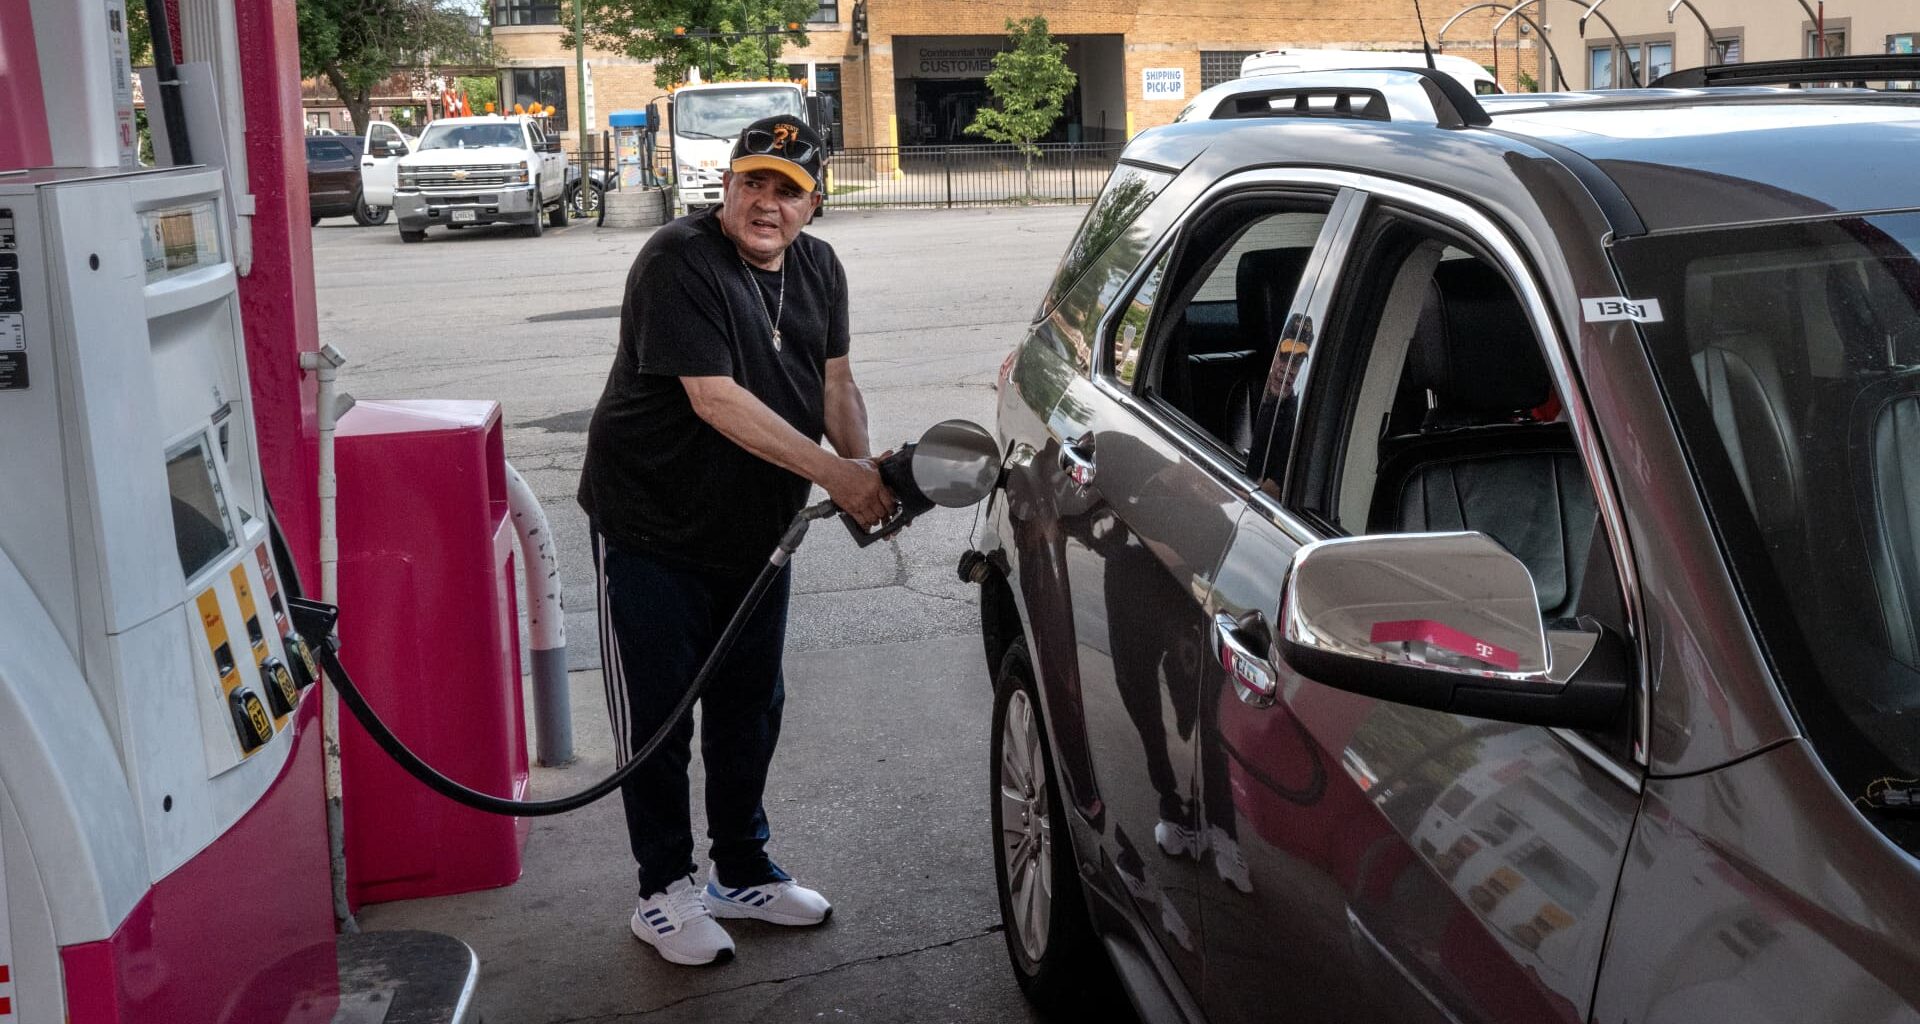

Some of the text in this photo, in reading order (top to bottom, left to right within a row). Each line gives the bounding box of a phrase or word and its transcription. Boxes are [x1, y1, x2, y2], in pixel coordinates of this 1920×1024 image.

[919, 47, 975, 57] Continental
[1145, 70, 1181, 80] SHIPPING
[1146, 81, 1181, 92] PICK-UP
[1597, 302, 1647, 317] 1361
[251, 706, 267, 731] 87
